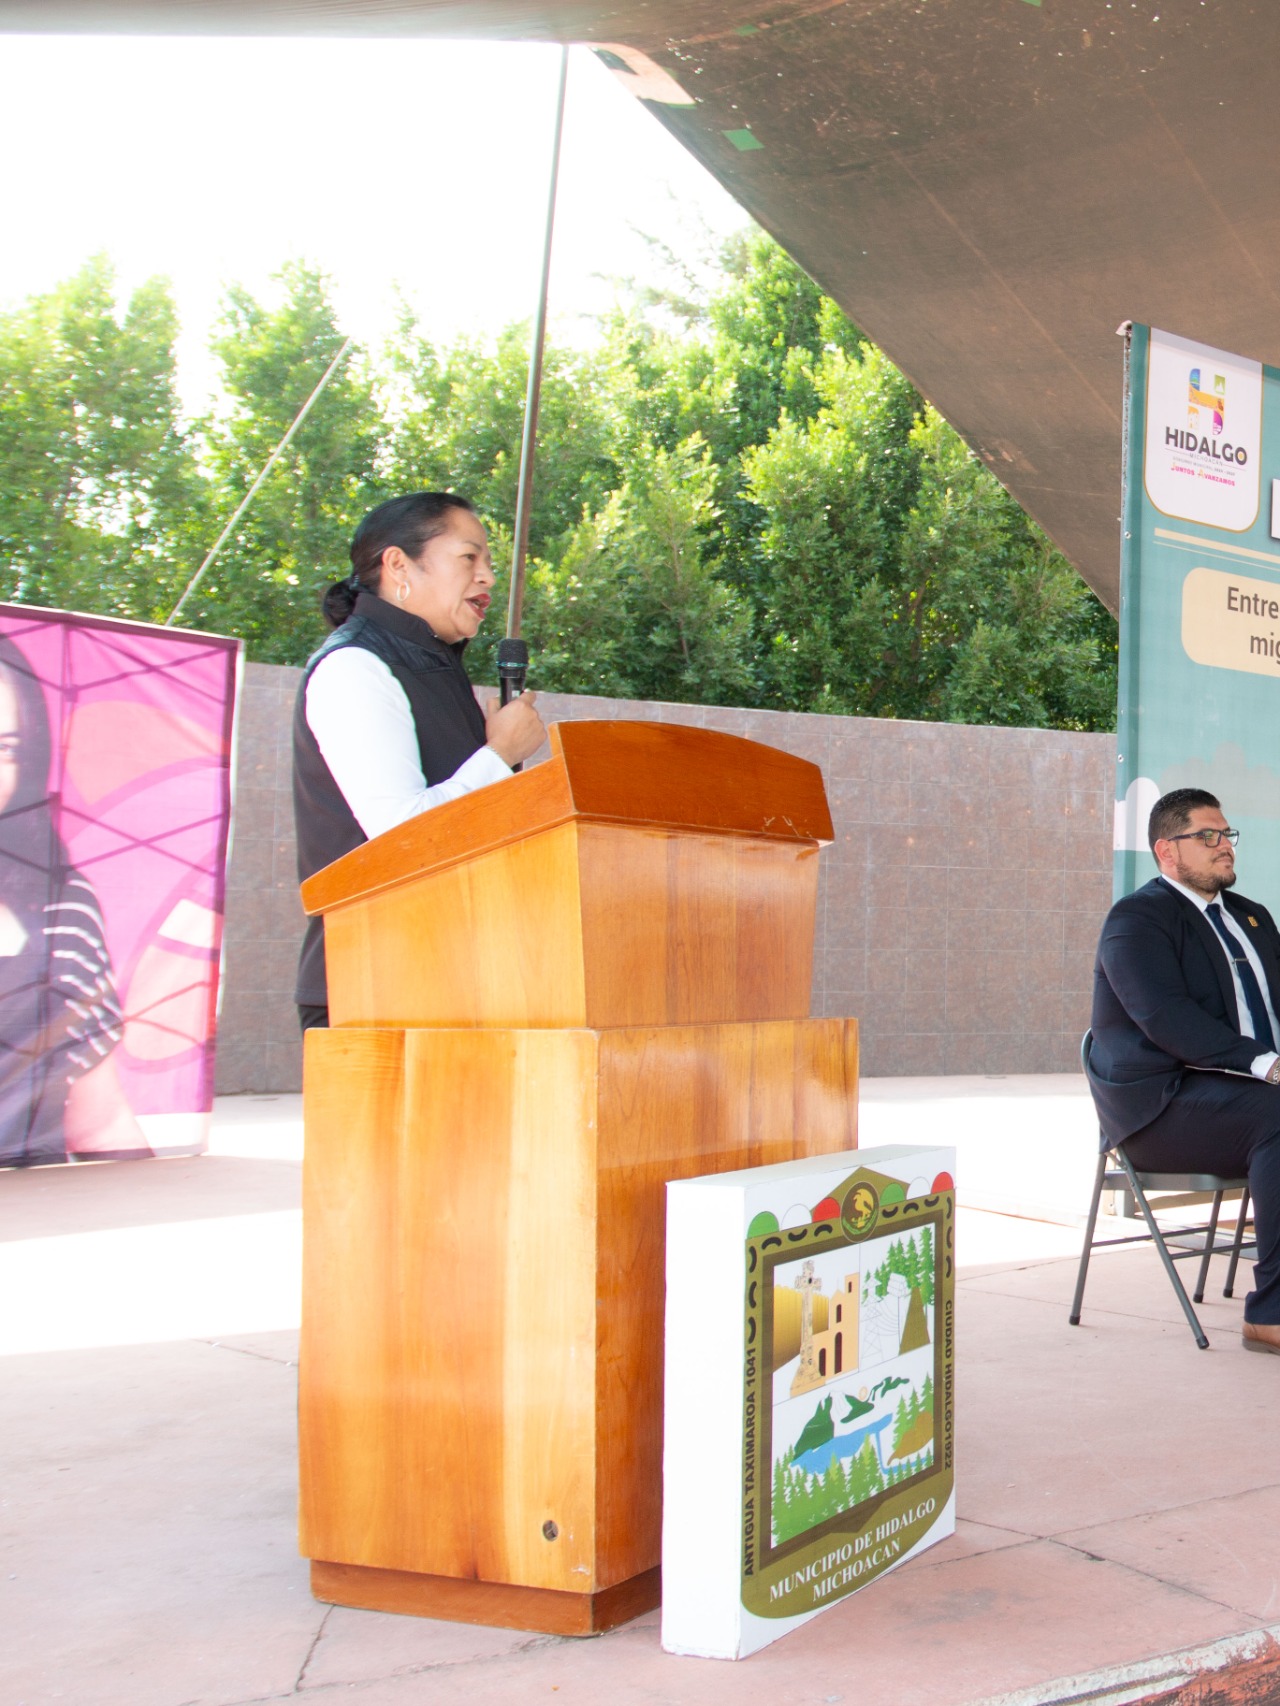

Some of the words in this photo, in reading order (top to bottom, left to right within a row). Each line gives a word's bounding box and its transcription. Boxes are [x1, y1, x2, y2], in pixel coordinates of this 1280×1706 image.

[1165, 426, 1247, 465] HIDALGO
[944, 1299, 953, 1359] CIUDAD
[746, 1347, 757, 1388] 1041
[745, 1391, 756, 1495] TAXIMAROA
[744, 1497, 755, 1576] ANTIGUA
[769, 1543, 852, 1603] MUNICIPIO
[854, 1530, 873, 1555] DE
[875, 1497, 937, 1543] HIDALGO
[812, 1537, 901, 1602] MICHOACAN
